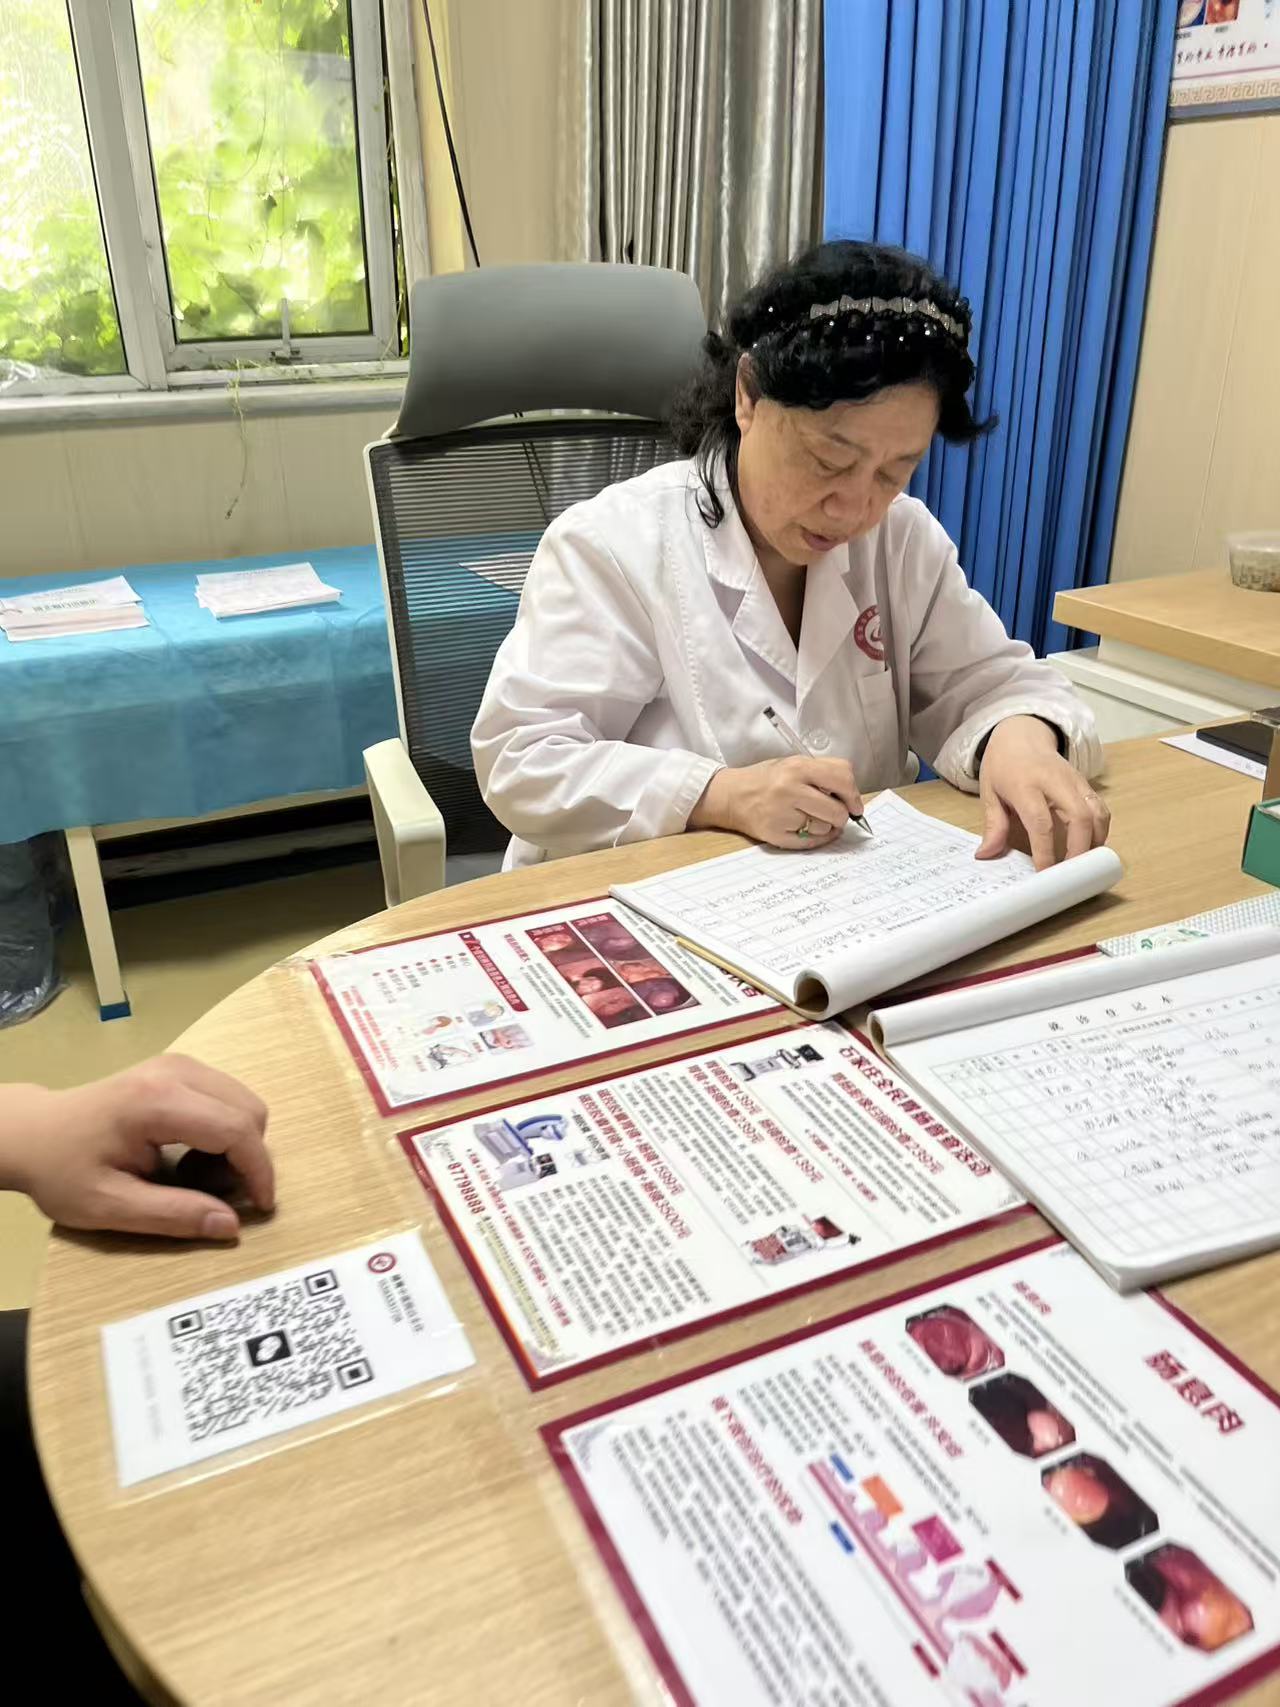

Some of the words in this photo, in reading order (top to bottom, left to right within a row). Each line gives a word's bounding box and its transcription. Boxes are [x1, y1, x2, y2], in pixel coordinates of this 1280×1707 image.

[597, 1088, 684, 1195] 磁控胶囊胃镜+肠镜1599元
[688, 1065, 764, 1144] 胃镜+肠镜检查239元
[705, 1060, 762, 1115] 胃镜检查139元
[758, 1118, 824, 1183] 肠镜检查139元
[839, 1045, 992, 1177] 石家庄全民胃肠普查活动
[447, 1162, 486, 1215] 87798888
[1145, 1350, 1245, 1435] 肠息肉
